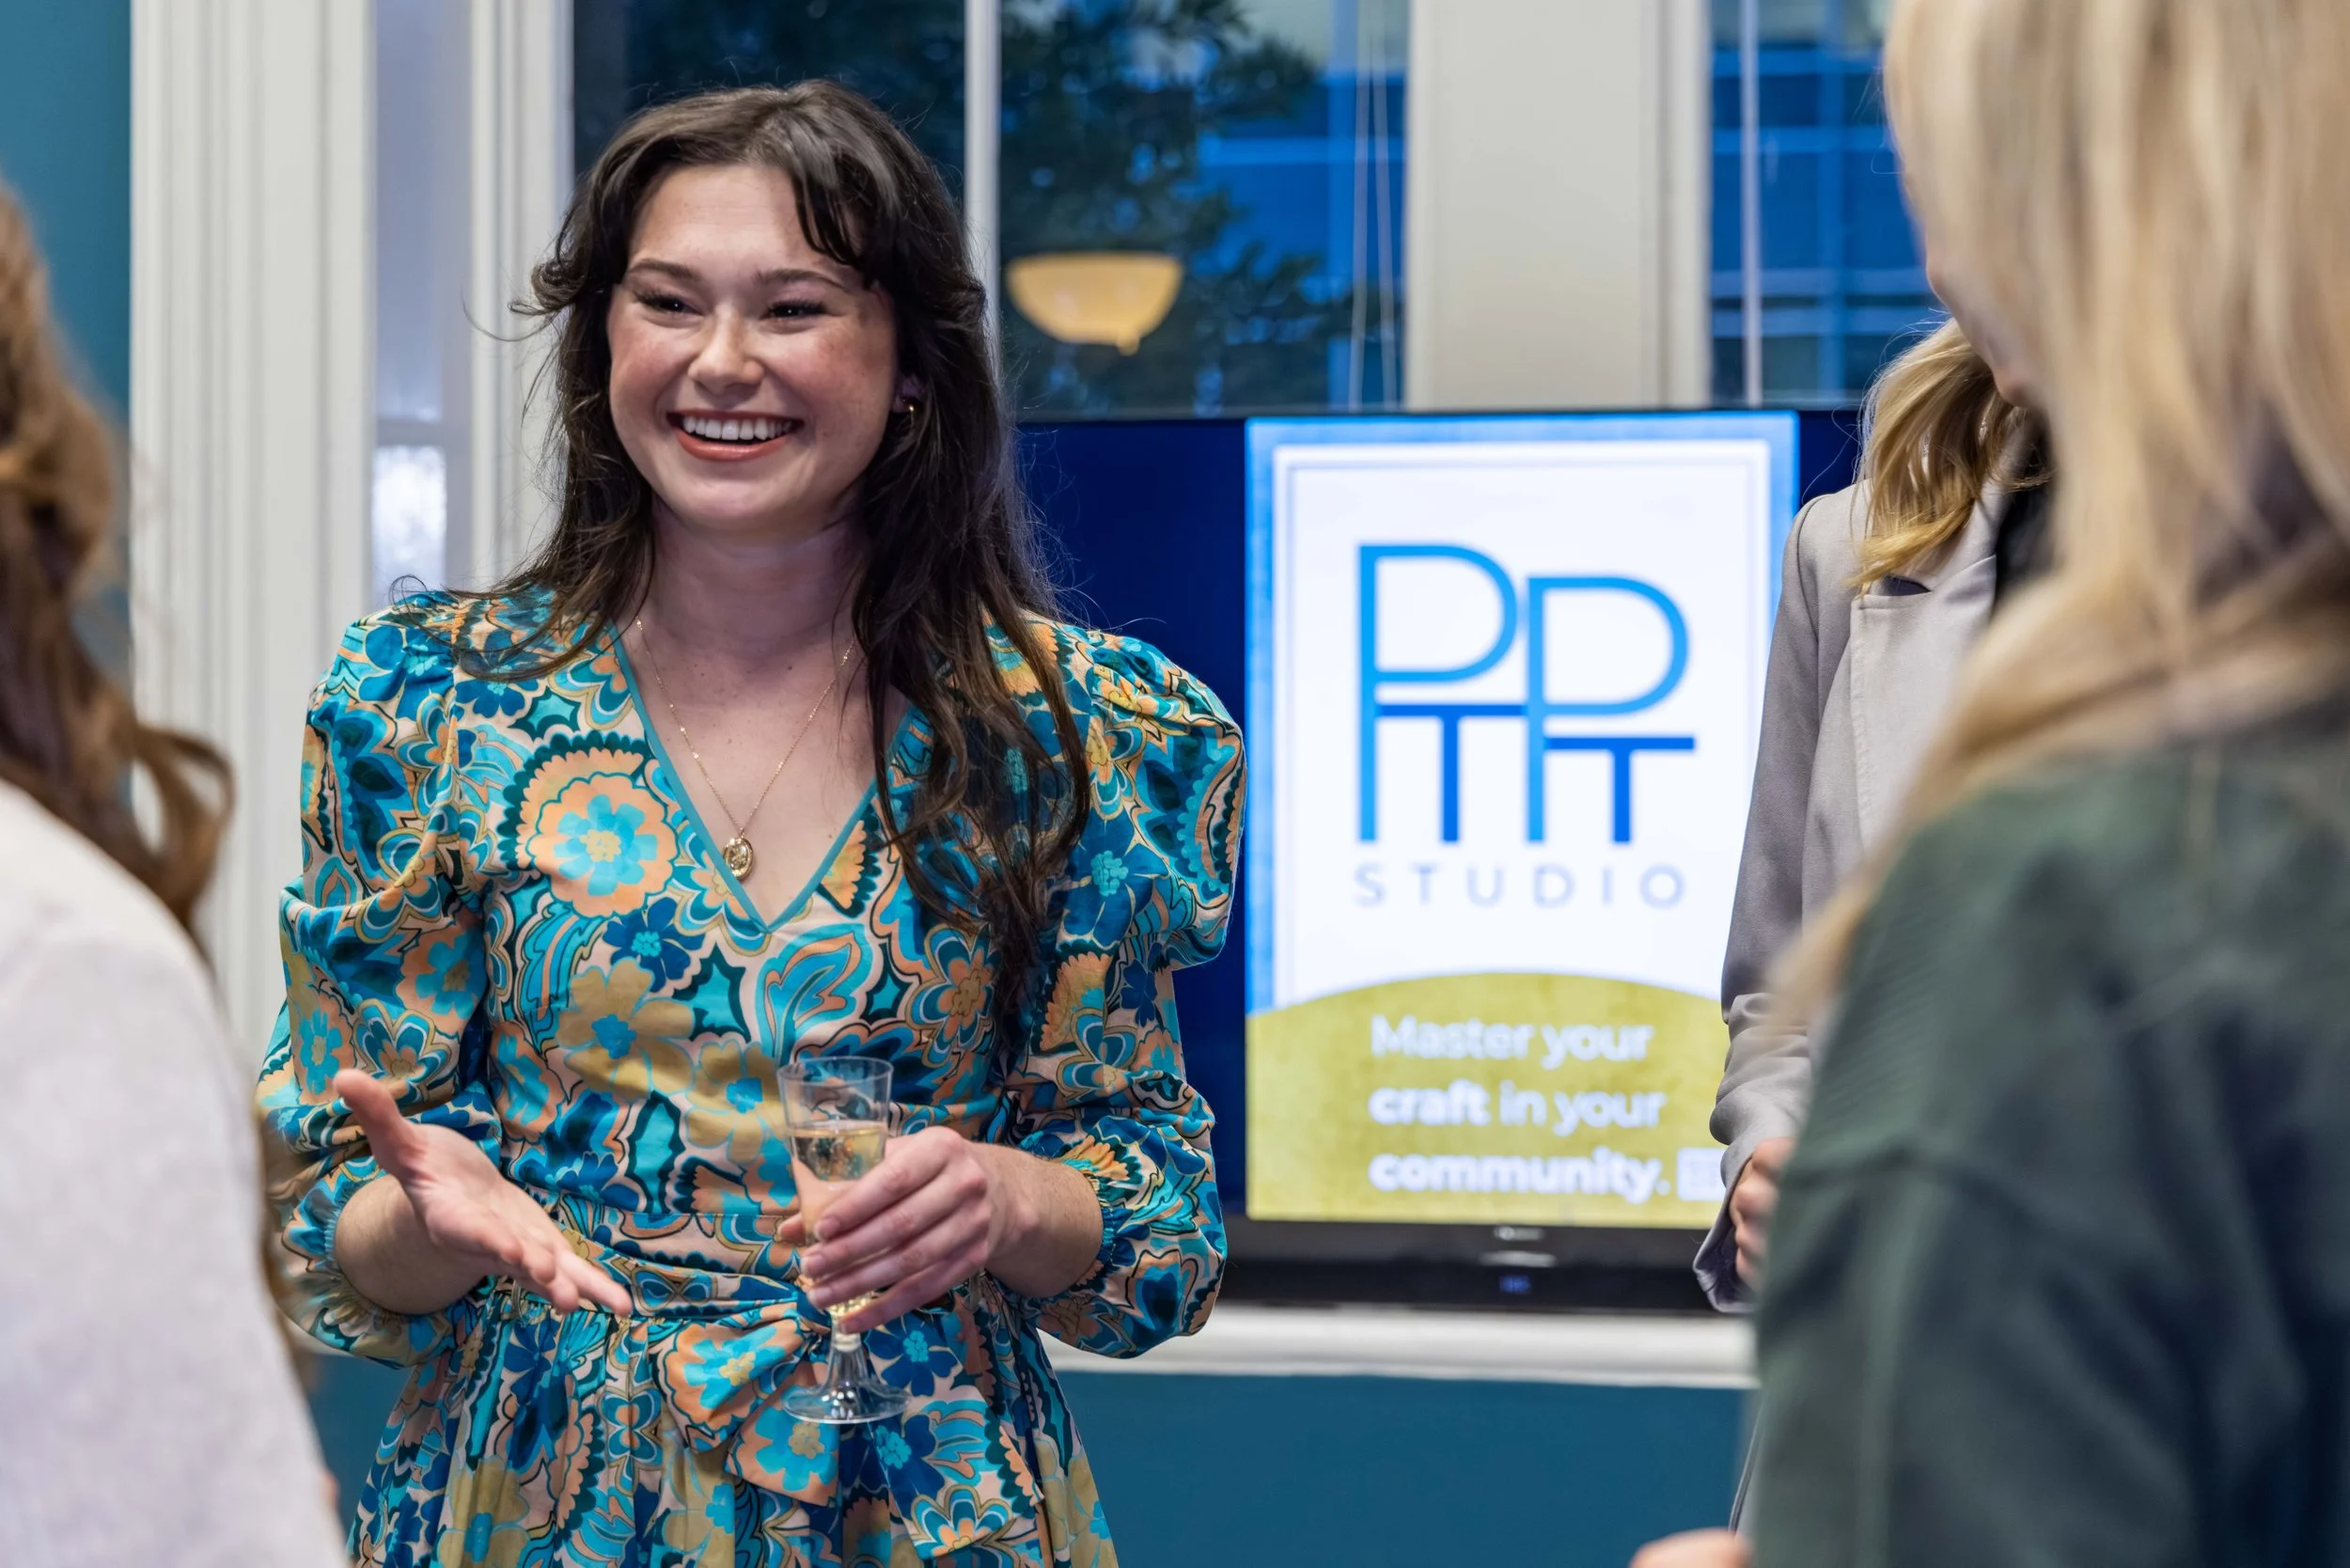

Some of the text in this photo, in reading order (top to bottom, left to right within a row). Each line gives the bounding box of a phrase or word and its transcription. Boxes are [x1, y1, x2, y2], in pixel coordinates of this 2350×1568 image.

[1354, 863, 1686, 909] STUDIO
[1370, 1015, 1654, 1070] Master your
[1368, 1079, 1667, 1137] craft in your
[1368, 1146, 1670, 1204] community.
